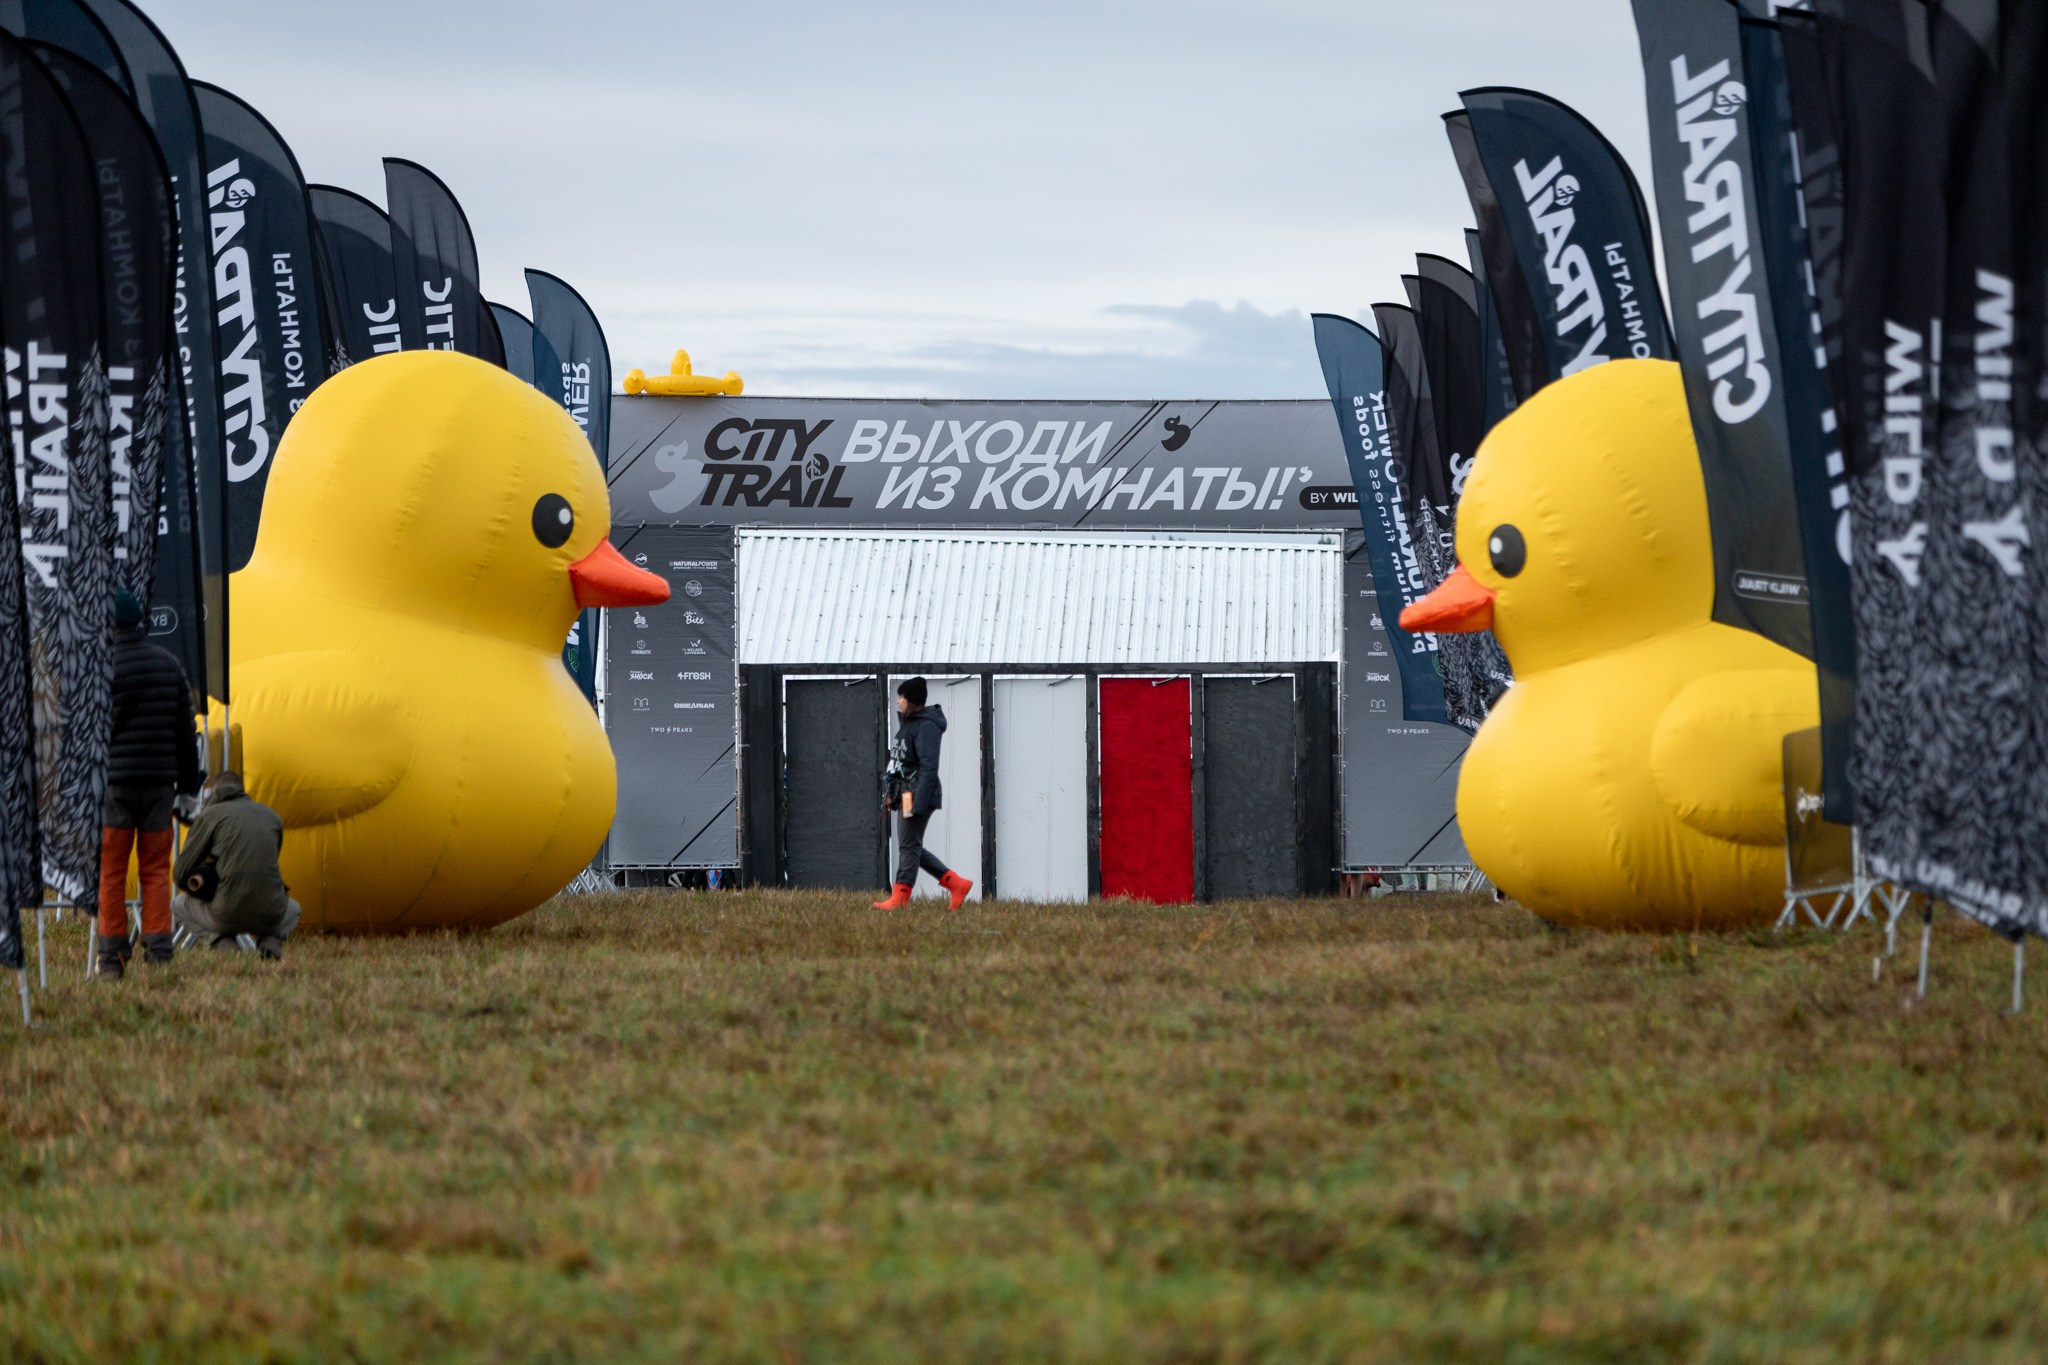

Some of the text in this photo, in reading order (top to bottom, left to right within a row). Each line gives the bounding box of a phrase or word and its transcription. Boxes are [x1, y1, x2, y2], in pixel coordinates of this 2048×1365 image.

[704, 417, 835, 462] CITY
[840, 419, 1113, 471] ВЫХОДИ
[700, 453, 854, 509] TRAIL
[875, 466, 963, 510] ИЗ
[1310, 492, 1360, 504] BY WIL
